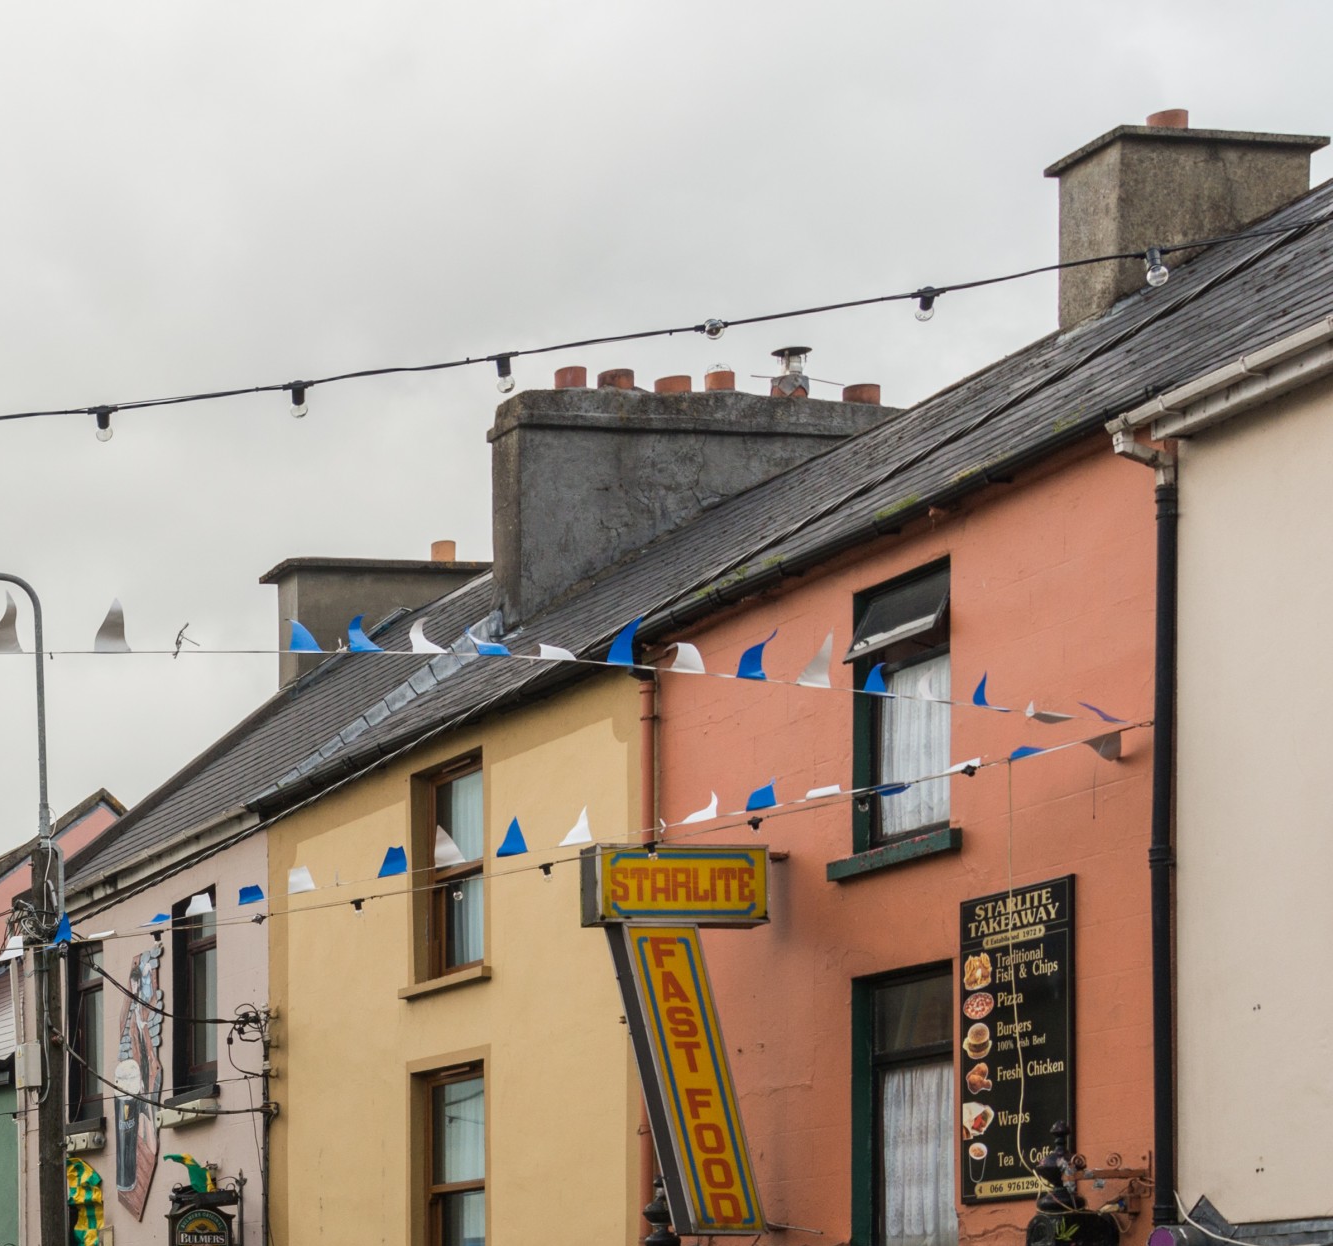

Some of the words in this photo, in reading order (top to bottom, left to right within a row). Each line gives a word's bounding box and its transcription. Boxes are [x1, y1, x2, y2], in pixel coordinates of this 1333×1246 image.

[611, 867, 755, 902] STARLITE
[974, 888, 1052, 920] STARLITE
[968, 902, 1059, 938] TAKEAWAY
[996, 943, 1044, 968] Traditional
[996, 966, 1014, 983] Fish
[1019, 963, 1027, 979] &
[1033, 959, 1058, 976] Chips
[649, 937, 701, 1073] FAST
[997, 992, 1023, 1007] Pizza
[997, 1020, 1032, 1037] Burgers
[997, 1040, 1014, 1051] 100%
[1033, 1033, 1046, 1045] Beef
[997, 1063, 1021, 1082] Fresh
[1027, 1058, 1064, 1077] Chicken
[998, 1111, 1030, 1127] Wraps
[685, 1088, 744, 1224] FOOD
[998, 1152, 1014, 1167] Tea
[990, 1181, 1003, 1193] 066
[1007, 1179, 1039, 1192] 9761296
[180, 1233, 225, 1243] BULMERS
